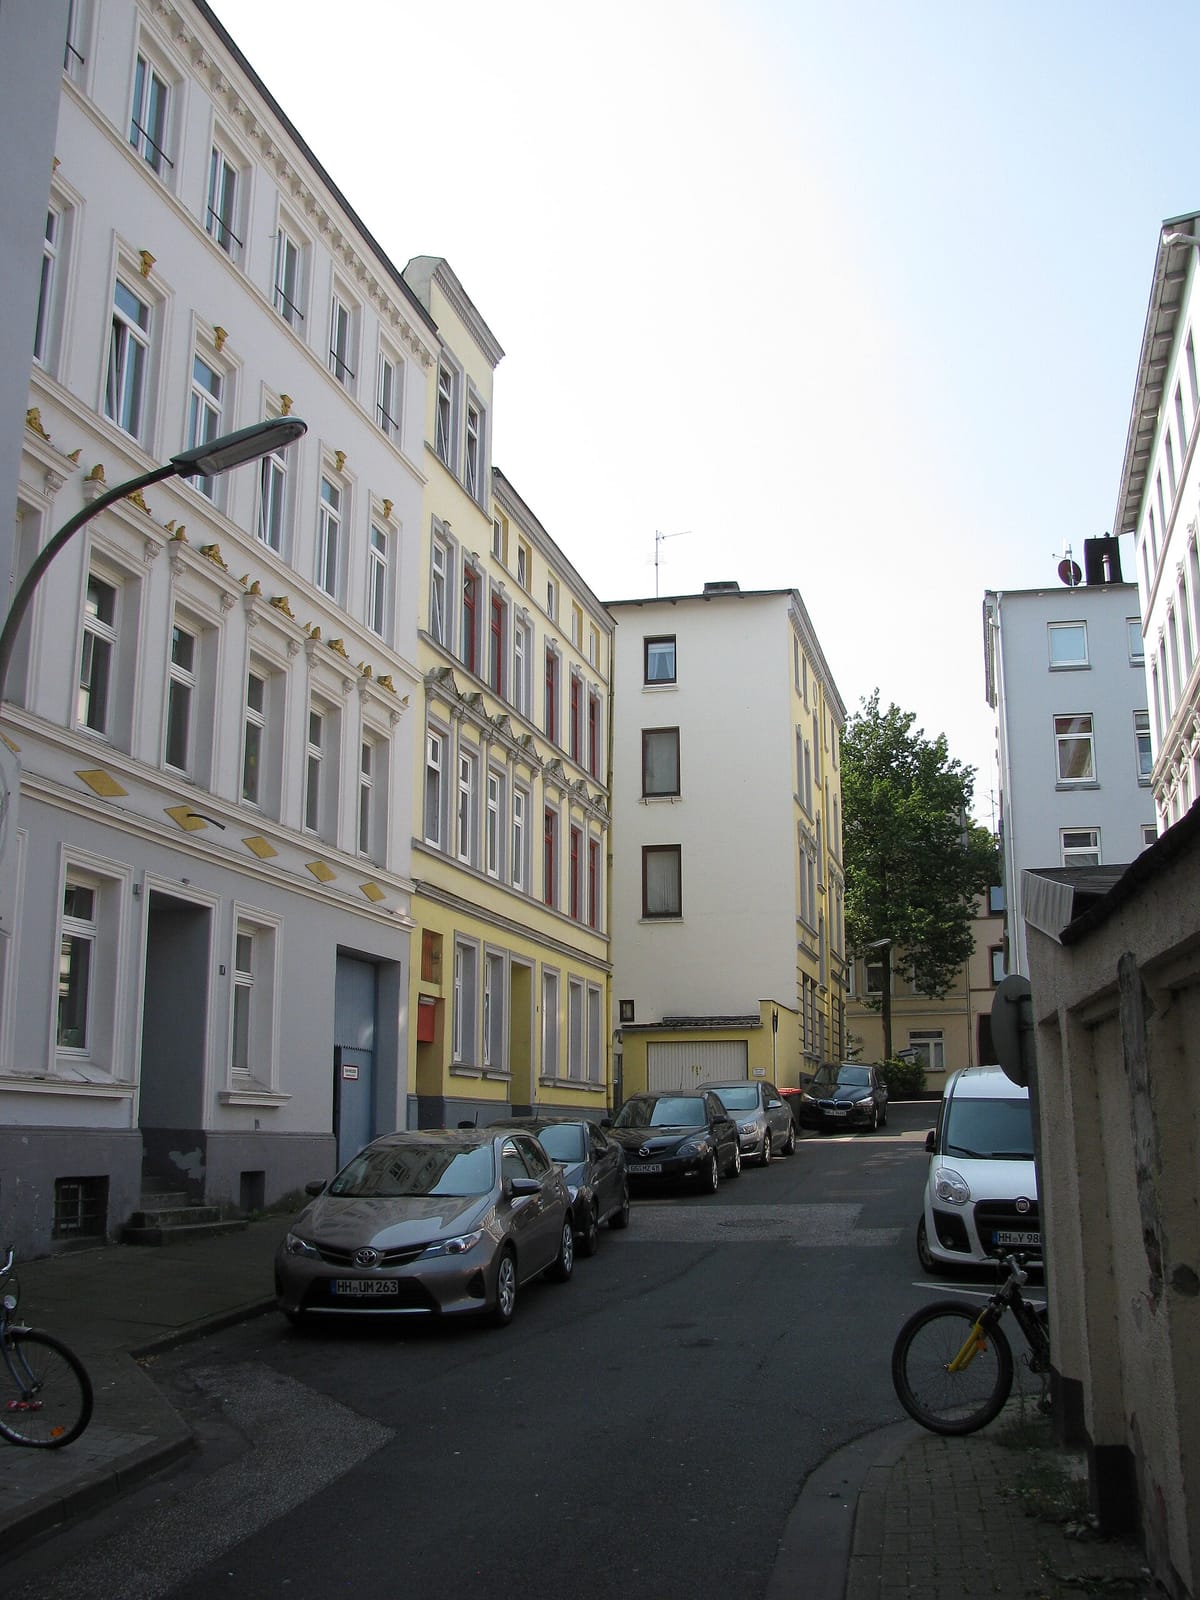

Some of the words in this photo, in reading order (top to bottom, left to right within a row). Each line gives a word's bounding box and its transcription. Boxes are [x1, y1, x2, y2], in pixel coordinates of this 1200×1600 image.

[998, 1233, 1011, 1242] HH
[1027, 1233, 1040, 1243] 98
[337, 1281, 352, 1293] HH
[360, 1281, 374, 1293] UM
[376, 1281, 397, 1293] 263
